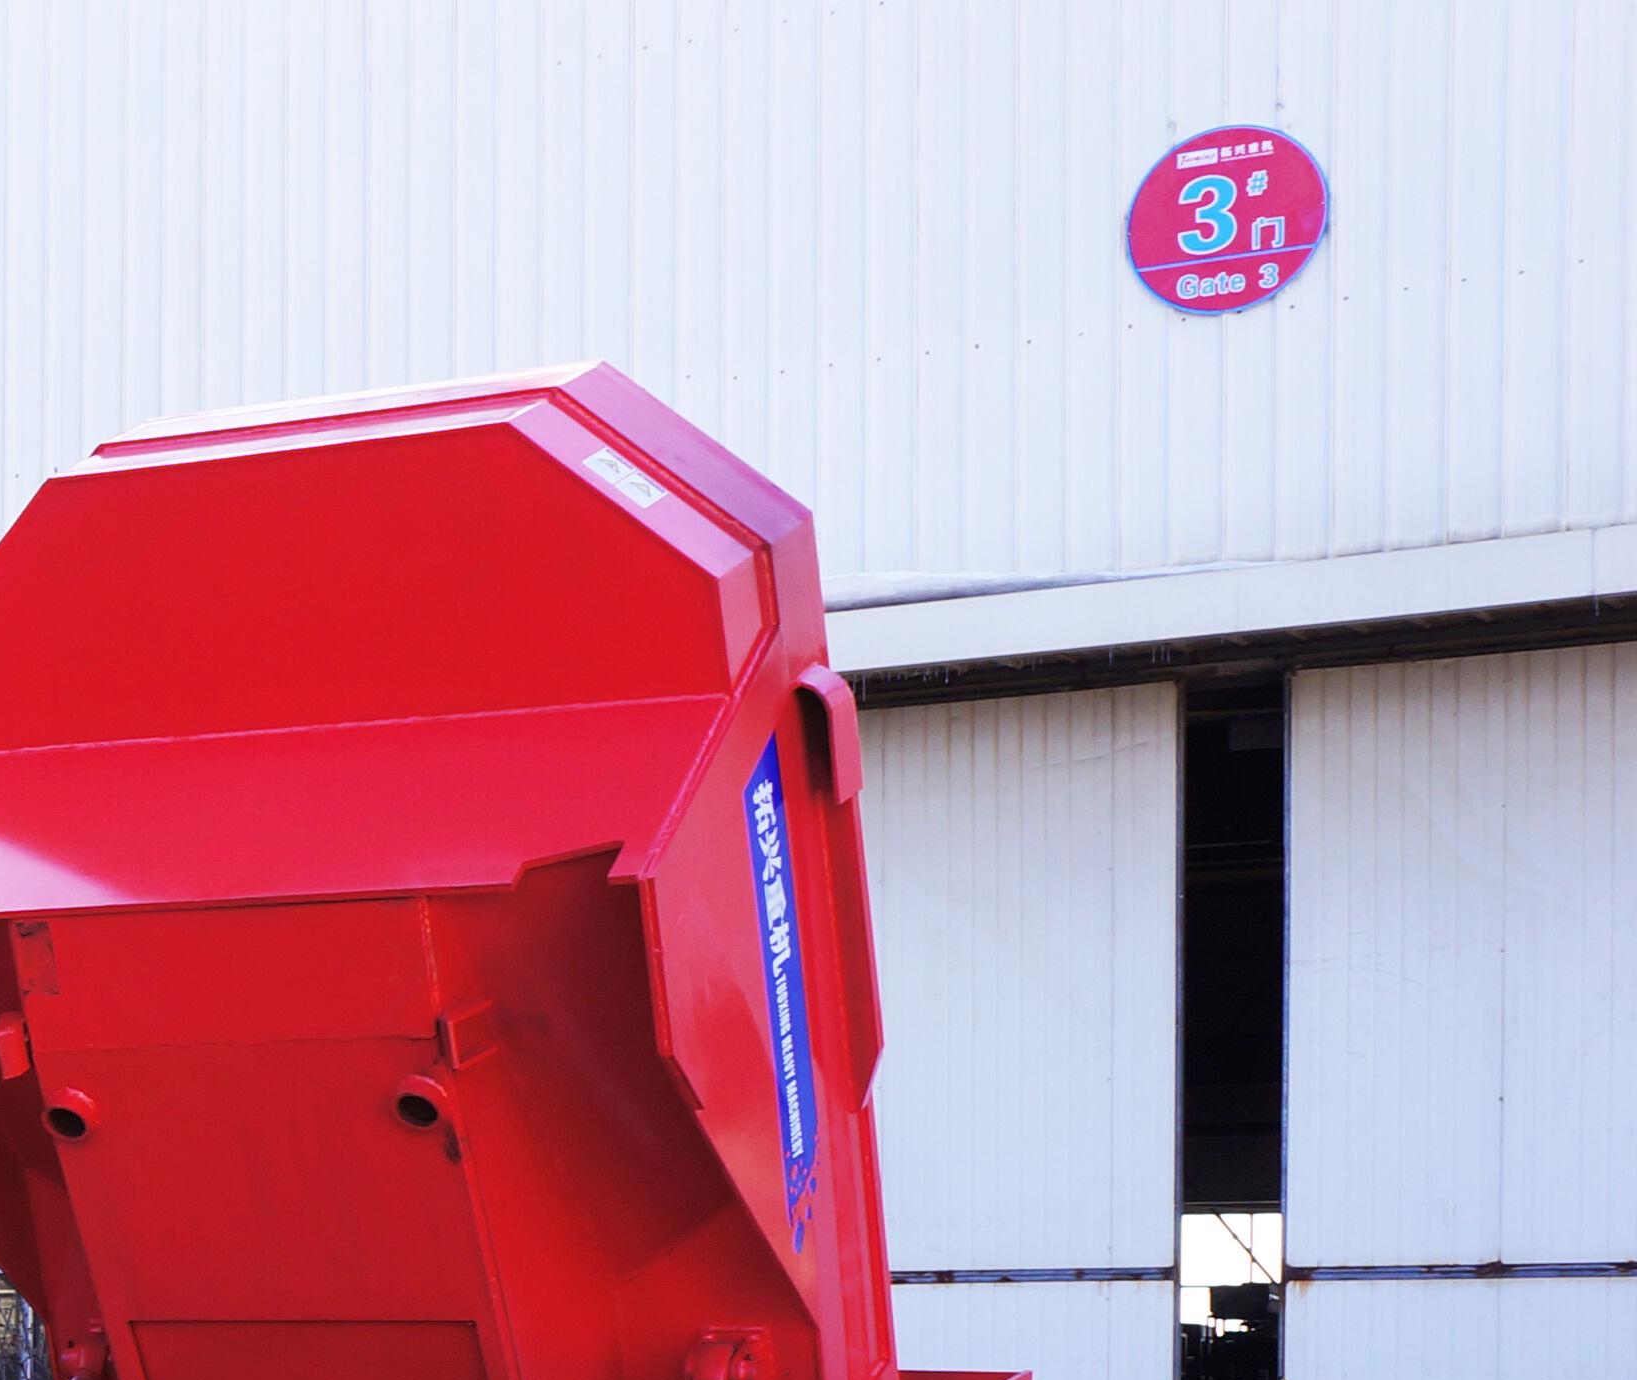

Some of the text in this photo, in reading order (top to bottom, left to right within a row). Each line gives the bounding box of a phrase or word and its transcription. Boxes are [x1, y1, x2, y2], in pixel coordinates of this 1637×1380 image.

[1176, 262, 1280, 300] Gate 3
[752, 779, 791, 977] 拓兴重机
